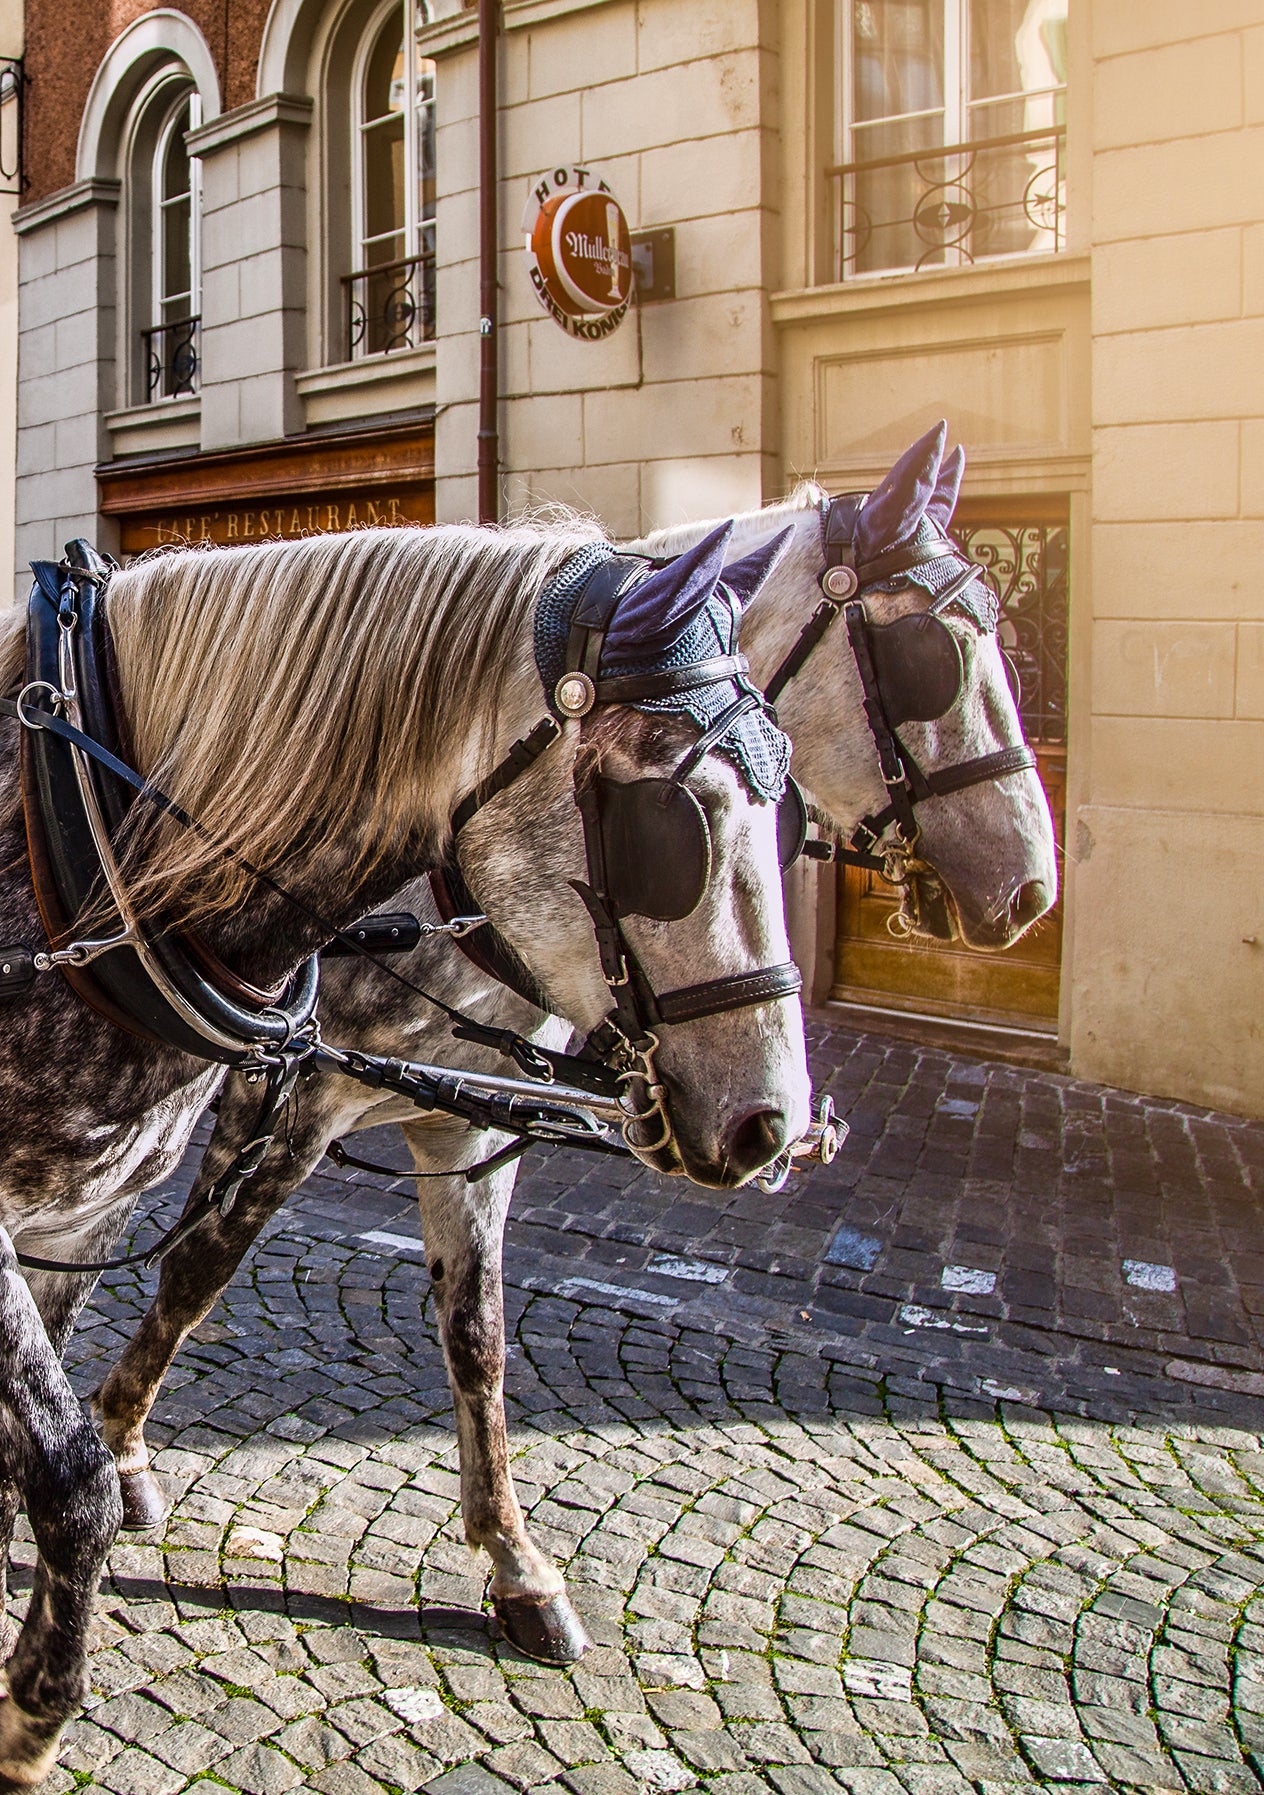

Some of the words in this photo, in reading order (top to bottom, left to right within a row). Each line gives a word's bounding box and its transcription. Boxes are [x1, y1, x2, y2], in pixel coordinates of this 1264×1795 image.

[535, 168, 611, 204] HOT
[529, 265, 569, 330] DREI
[572, 300, 630, 340] KÖNIG
[227, 498, 401, 537] RESTAURANT
